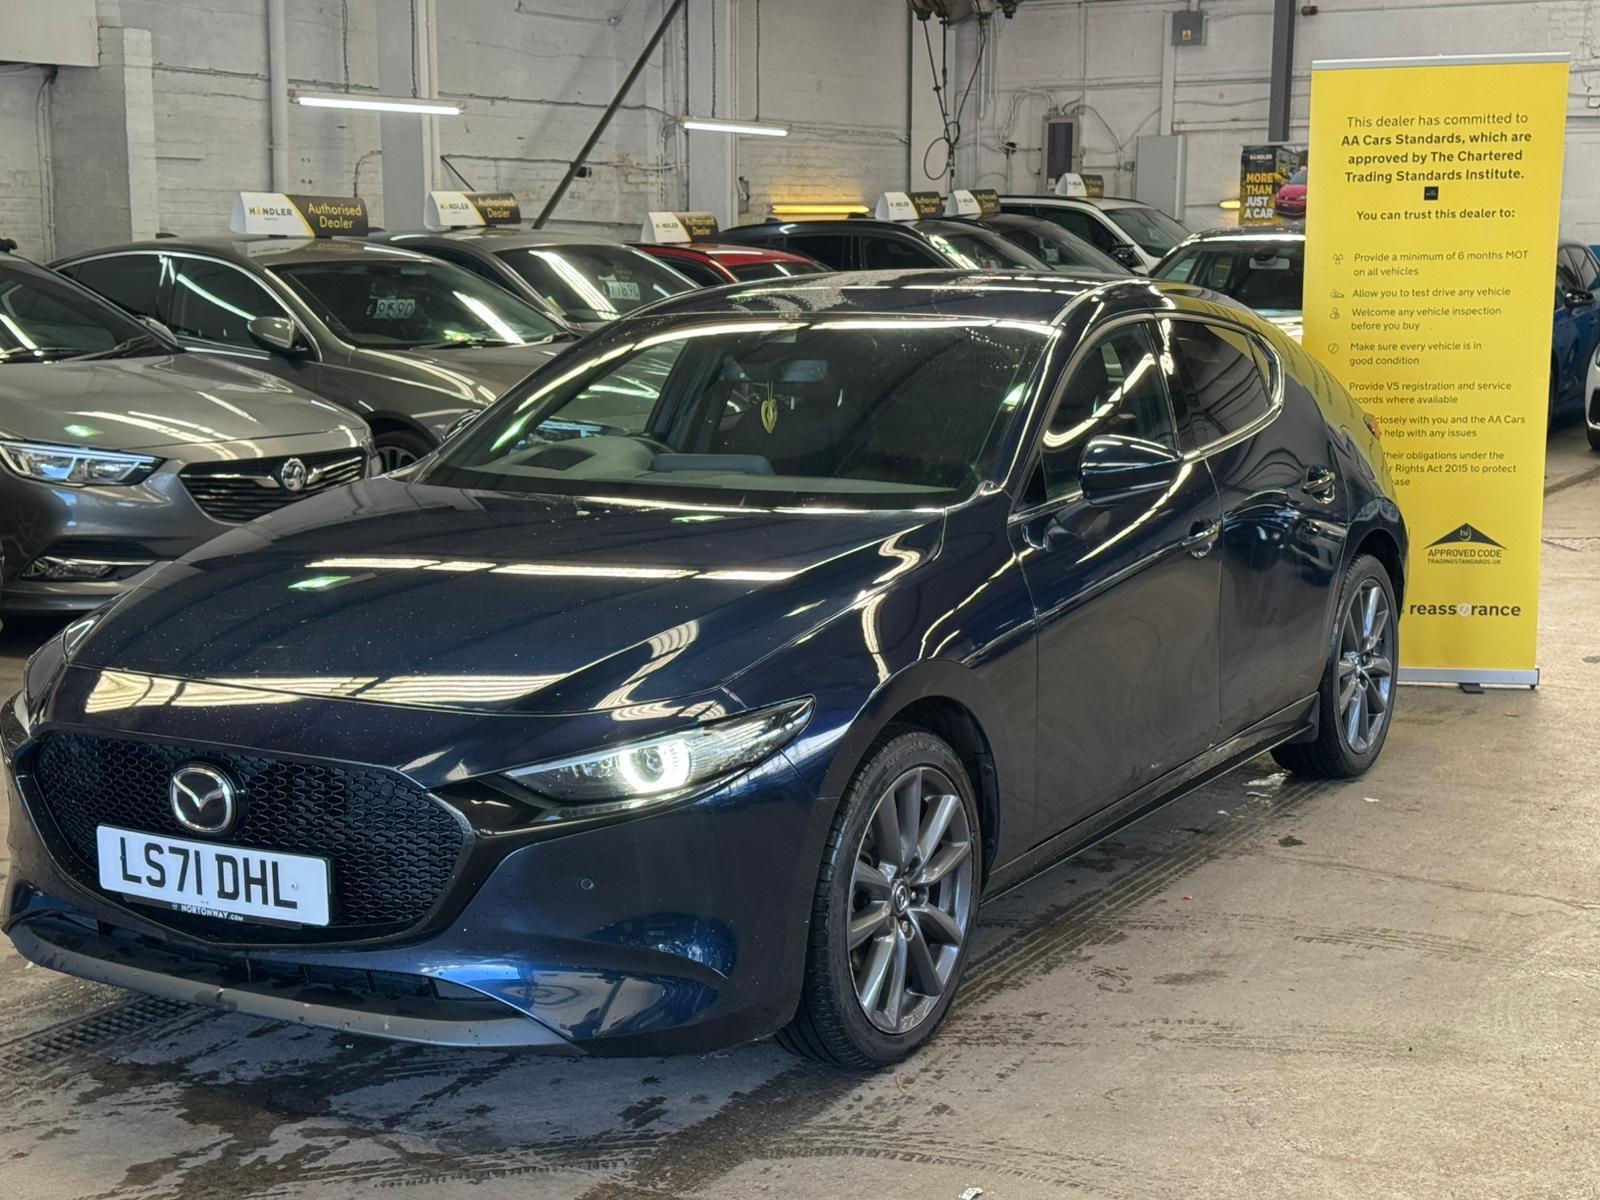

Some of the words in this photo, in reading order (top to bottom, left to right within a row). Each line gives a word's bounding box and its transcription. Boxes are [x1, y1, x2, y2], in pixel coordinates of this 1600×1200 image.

[1347, 116, 1372, 128] This
[1376, 115, 1415, 127] dealer
[1418, 114, 1440, 126] has
[1443, 112, 1512, 125] committed
[1516, 113, 1528, 124] to
[1341, 135, 1360, 146] AA
[1363, 134, 1392, 146] Cars
[1395, 132, 1465, 145] Standards,
[1469, 131, 1508, 143] which
[1511, 133, 1532, 142] are
[1348, 152, 1409, 166] approved
[1412, 152, 1427, 165] by
[1430, 151, 1454, 162] The
[1457, 149, 1523, 161] Chartered
[1246, 172, 1274, 183] MORE
[1345, 171, 1393, 184] Trading
[1396, 169, 1462, 181] Standards
[1466, 168, 1524, 180] Institute.
[1246, 185, 1272, 195] THAN
[1245, 196, 1269, 207] JUST
[308, 202, 362, 216] Authorised
[487, 207, 511, 218] Dealer
[1244, 208, 1252, 218] A
[1253, 208, 1274, 218] CAR
[1356, 210, 1377, 221] You
[1380, 211, 1400, 220] can
[1404, 209, 1432, 220] trust
[1435, 208, 1456, 219] this
[1460, 208, 1496, 218] dealer
[1499, 207, 1515, 218] to:
[319, 216, 353, 229] Dealer
[1354, 253, 1390, 262] Provide
[1400, 251, 1444, 261] minimum
[1446, 251, 1456, 261] of
[1458, 250, 1465, 260] 6
[1467, 250, 1503, 260] months
[1505, 250, 1529, 260] MOT
[1353, 268, 1365, 277] on
[1367, 267, 1378, 276] all
[1380, 266, 1419, 276] vehicles
[1352, 289, 1378, 298] Allow
[1381, 291, 1397, 300] you
[1400, 289, 1409, 297] to
[1412, 288, 1429, 297] test
[1432, 287, 1456, 297] drive
[1458, 288, 1475, 298] any
[1477, 287, 1511, 296] vehicle
[1352, 307, 1395, 317] Welcome
[1398, 309, 1415, 318] any
[1416, 306, 1450, 316] vehicle
[1452, 306, 1502, 317] inspection
[1351, 321, 1381, 331] before
[1383, 323, 1400, 332] you
[1402, 321, 1420, 331] buy
[1350, 342, 1375, 351] Make
[1378, 343, 1398, 351] sure
[1400, 343, 1426, 352] every
[1428, 341, 1461, 351] vehicle
[1463, 341, 1471, 350] is
[1473, 341, 1482, 350] in
[1350, 356, 1373, 367] good
[1375, 356, 1420, 365] condition
[1349, 382, 1384, 391] Provide
[1386, 381, 1399, 390] V5
[1402, 381, 1455, 392] registration
[1457, 381, 1475, 390] and
[1477, 381, 1512, 390] service
[1353, 395, 1384, 404] cords
[1386, 395, 1415, 404] where
[1416, 395, 1458, 404] available
[1375, 415, 1407, 425] closely
[1409, 415, 1429, 424] with
[1432, 416, 1448, 425] you
[1450, 415, 1468, 424] and
[1470, 415, 1486, 424] the
[1487, 415, 1502, 424] AA
[1504, 414, 1526, 424] Cars
[1384, 429, 1405, 438] help
[1407, 429, 1427, 437] with
[1429, 430, 1446, 438] any
[1448, 429, 1477, 437] issues
[1406, 450, 1457, 461] obligations
[1460, 451, 1487, 460] under
[1489, 451, 1504, 460] the
[1395, 464, 1424, 474] Rights
[1427, 464, 1442, 473] Act
[1445, 464, 1468, 473] 2015
[1470, 464, 1480, 473] to
[1482, 464, 1517, 474] protect
[1428, 549, 1476, 558] APPROVED
[1477, 549, 1502, 558] CODE
[119, 836, 203, 896] LS71
[215, 853, 298, 910] DHL
